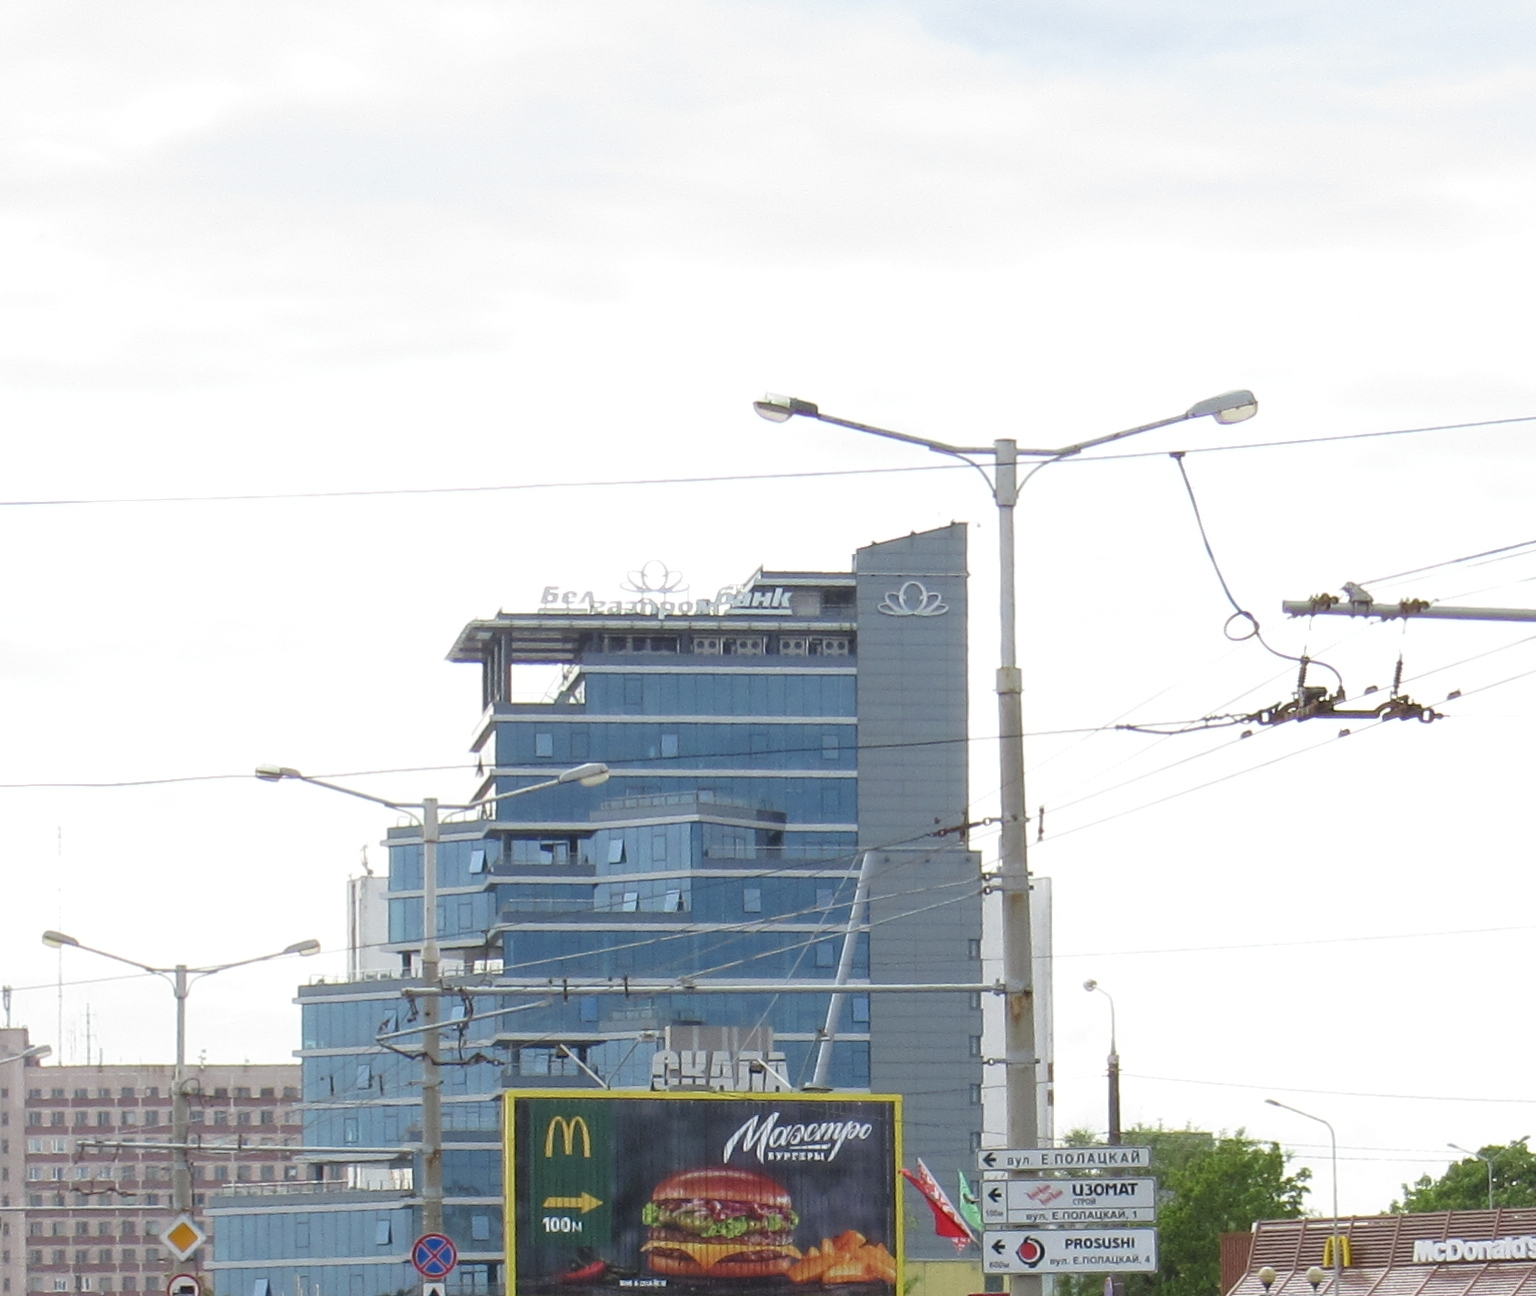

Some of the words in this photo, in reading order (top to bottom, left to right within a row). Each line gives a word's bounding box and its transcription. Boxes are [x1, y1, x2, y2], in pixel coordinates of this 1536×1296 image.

[722, 1111, 873, 1164] Маэстро
[767, 1151, 826, 1162] БУРГЕРЫ
[1007, 1157, 1033, 1167] вул.
[1041, 1150, 1141, 1166] Е.ПОЛАЦКАЙ
[1064, 1237, 1135, 1250] PROSUSHI
